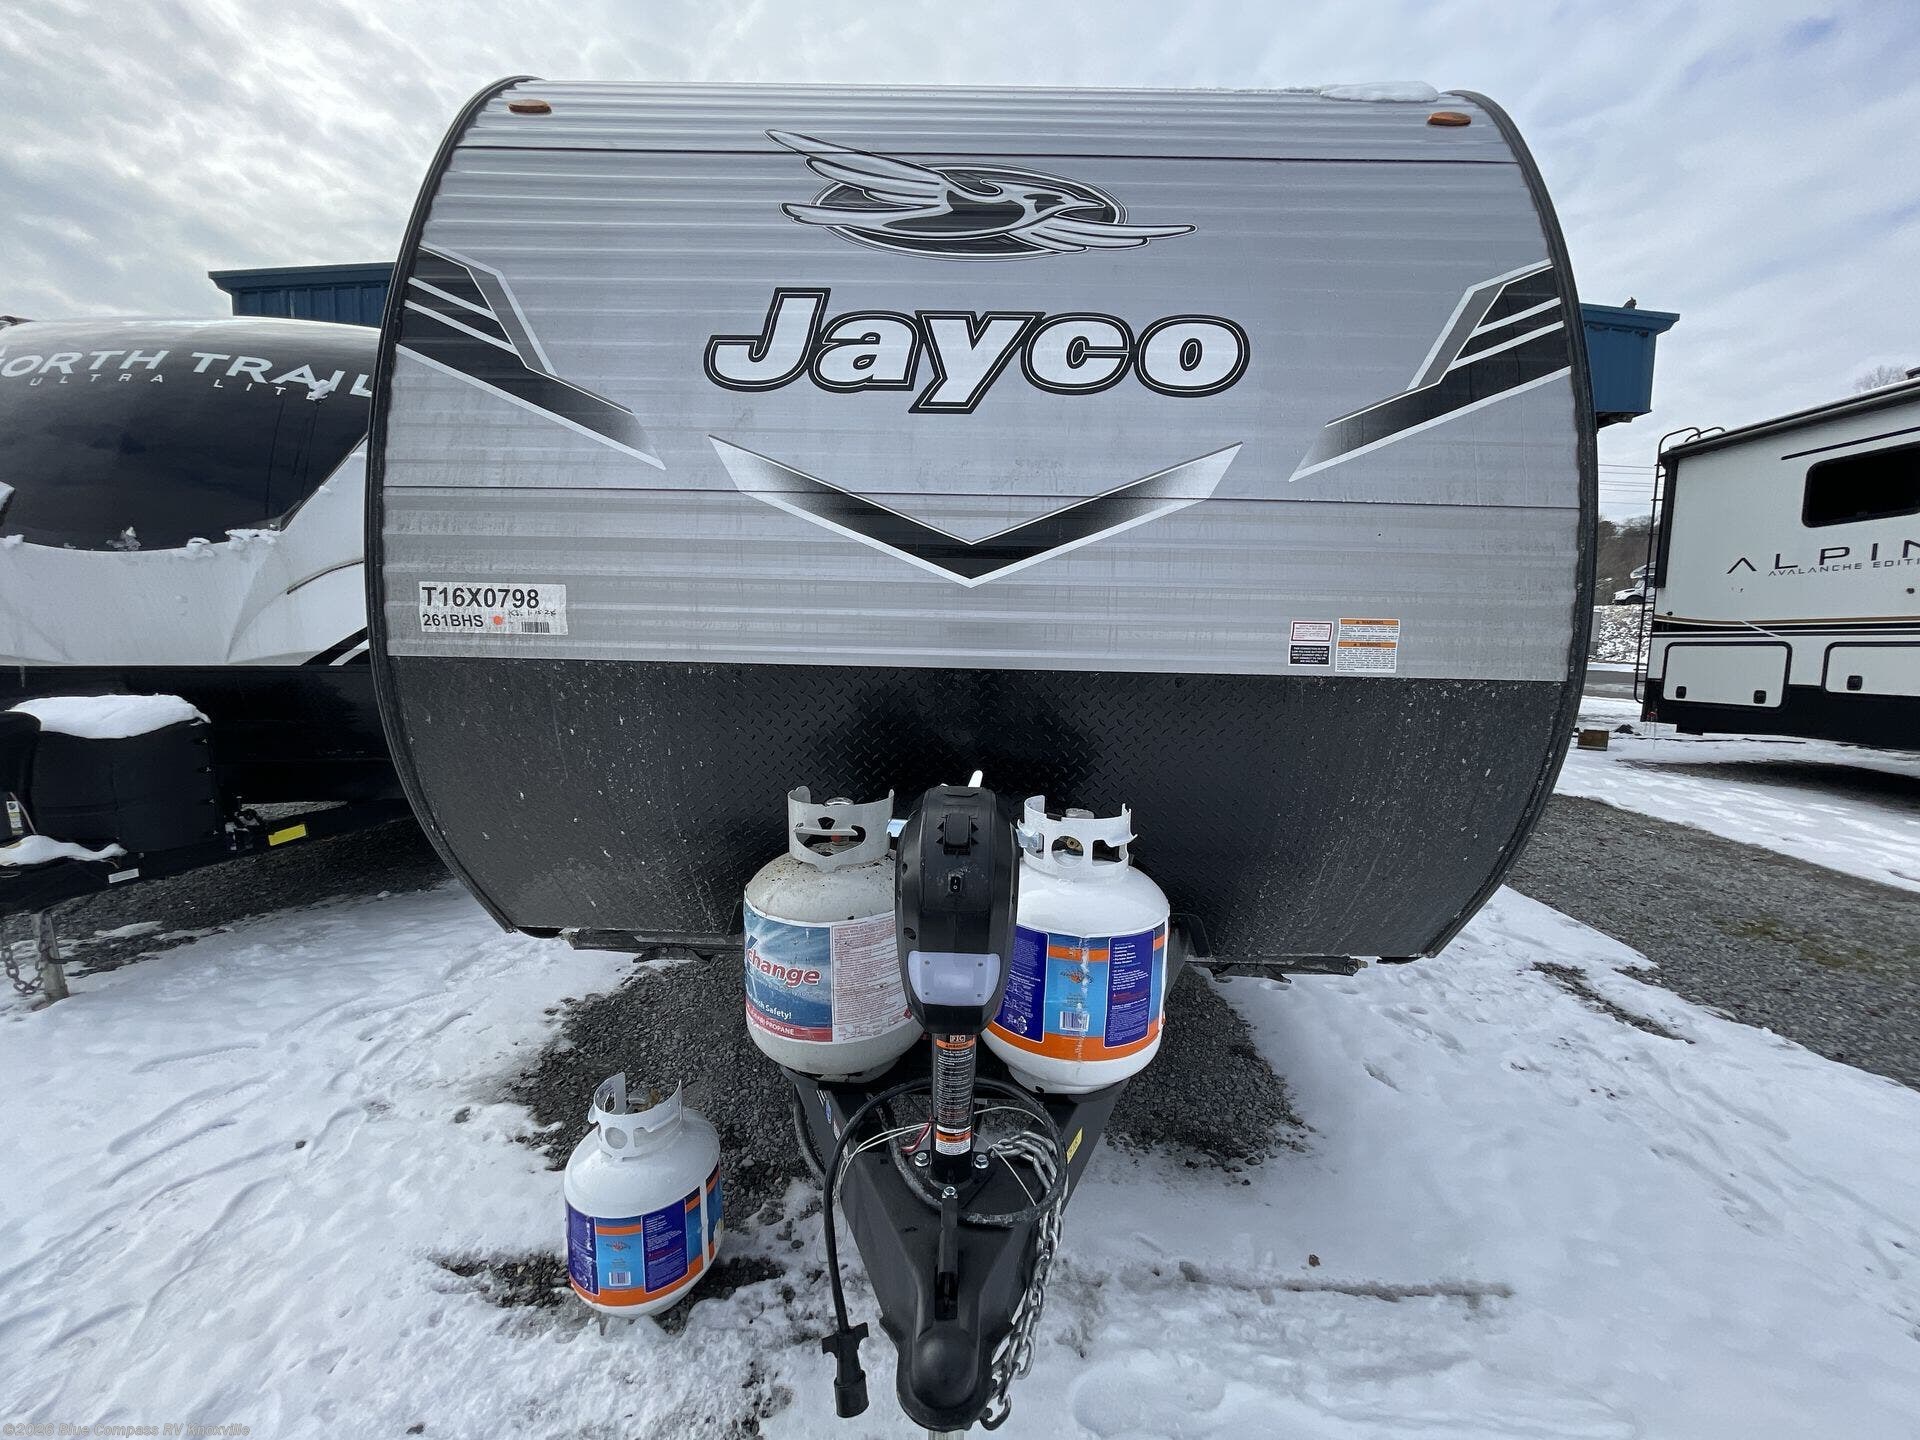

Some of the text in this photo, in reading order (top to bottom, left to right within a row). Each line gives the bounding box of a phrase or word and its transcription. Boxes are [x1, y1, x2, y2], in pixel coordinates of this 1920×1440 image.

[703, 287, 1251, 414] Jayco
[29, 373, 164, 386] ULTRA
[1768, 562, 1863, 577] AVALANCHE
[422, 586, 540, 609] T16X0798
[422, 613, 484, 628] 261BHS
